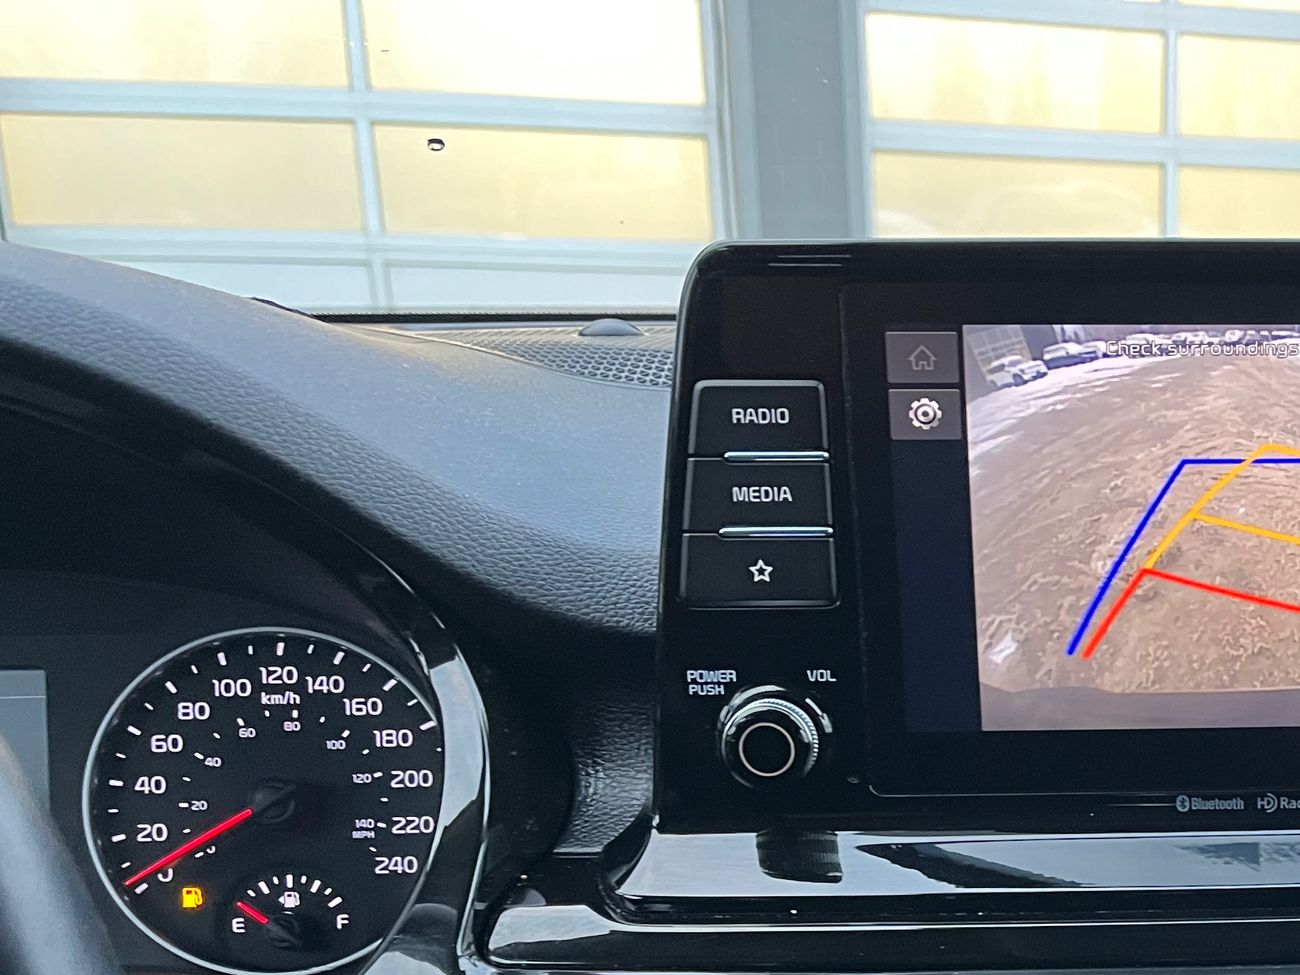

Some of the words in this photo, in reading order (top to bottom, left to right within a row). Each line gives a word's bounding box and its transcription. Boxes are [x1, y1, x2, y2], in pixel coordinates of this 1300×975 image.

[1106, 340, 1160, 355] Check
[1168, 340, 1298, 358] surroundings
[732, 408, 789, 424] RADIO
[732, 487, 792, 502] MEDIA
[259, 666, 298, 684] 120
[687, 670, 736, 682] POWER
[807, 670, 836, 681] VOL
[212, 679, 251, 696] 100
[305, 676, 344, 693] 140
[689, 684, 724, 695] PUSH
[261, 691, 300, 704] km/h
[178, 702, 210, 720] 80
[343, 698, 382, 715] 160
[239, 727, 256, 737] 60
[284, 722, 301, 731] 80
[151, 735, 183, 752] 60
[326, 740, 346, 749] 100
[373, 729, 413, 747] 180
[204, 757, 221, 767] 40
[135, 776, 166, 794] 40
[352, 774, 371, 783] 120
[391, 770, 433, 788] 200
[191, 801, 207, 810] 20
[1191, 797, 1244, 810] Bluetooth
[1258, 793, 1277, 812] HD
[355, 819, 374, 828] 140
[392, 816, 434, 834] 220
[137, 824, 167, 841] 20
[375, 856, 418, 874] 240
[232, 918, 245, 933] E
[337, 914, 349, 929] F
